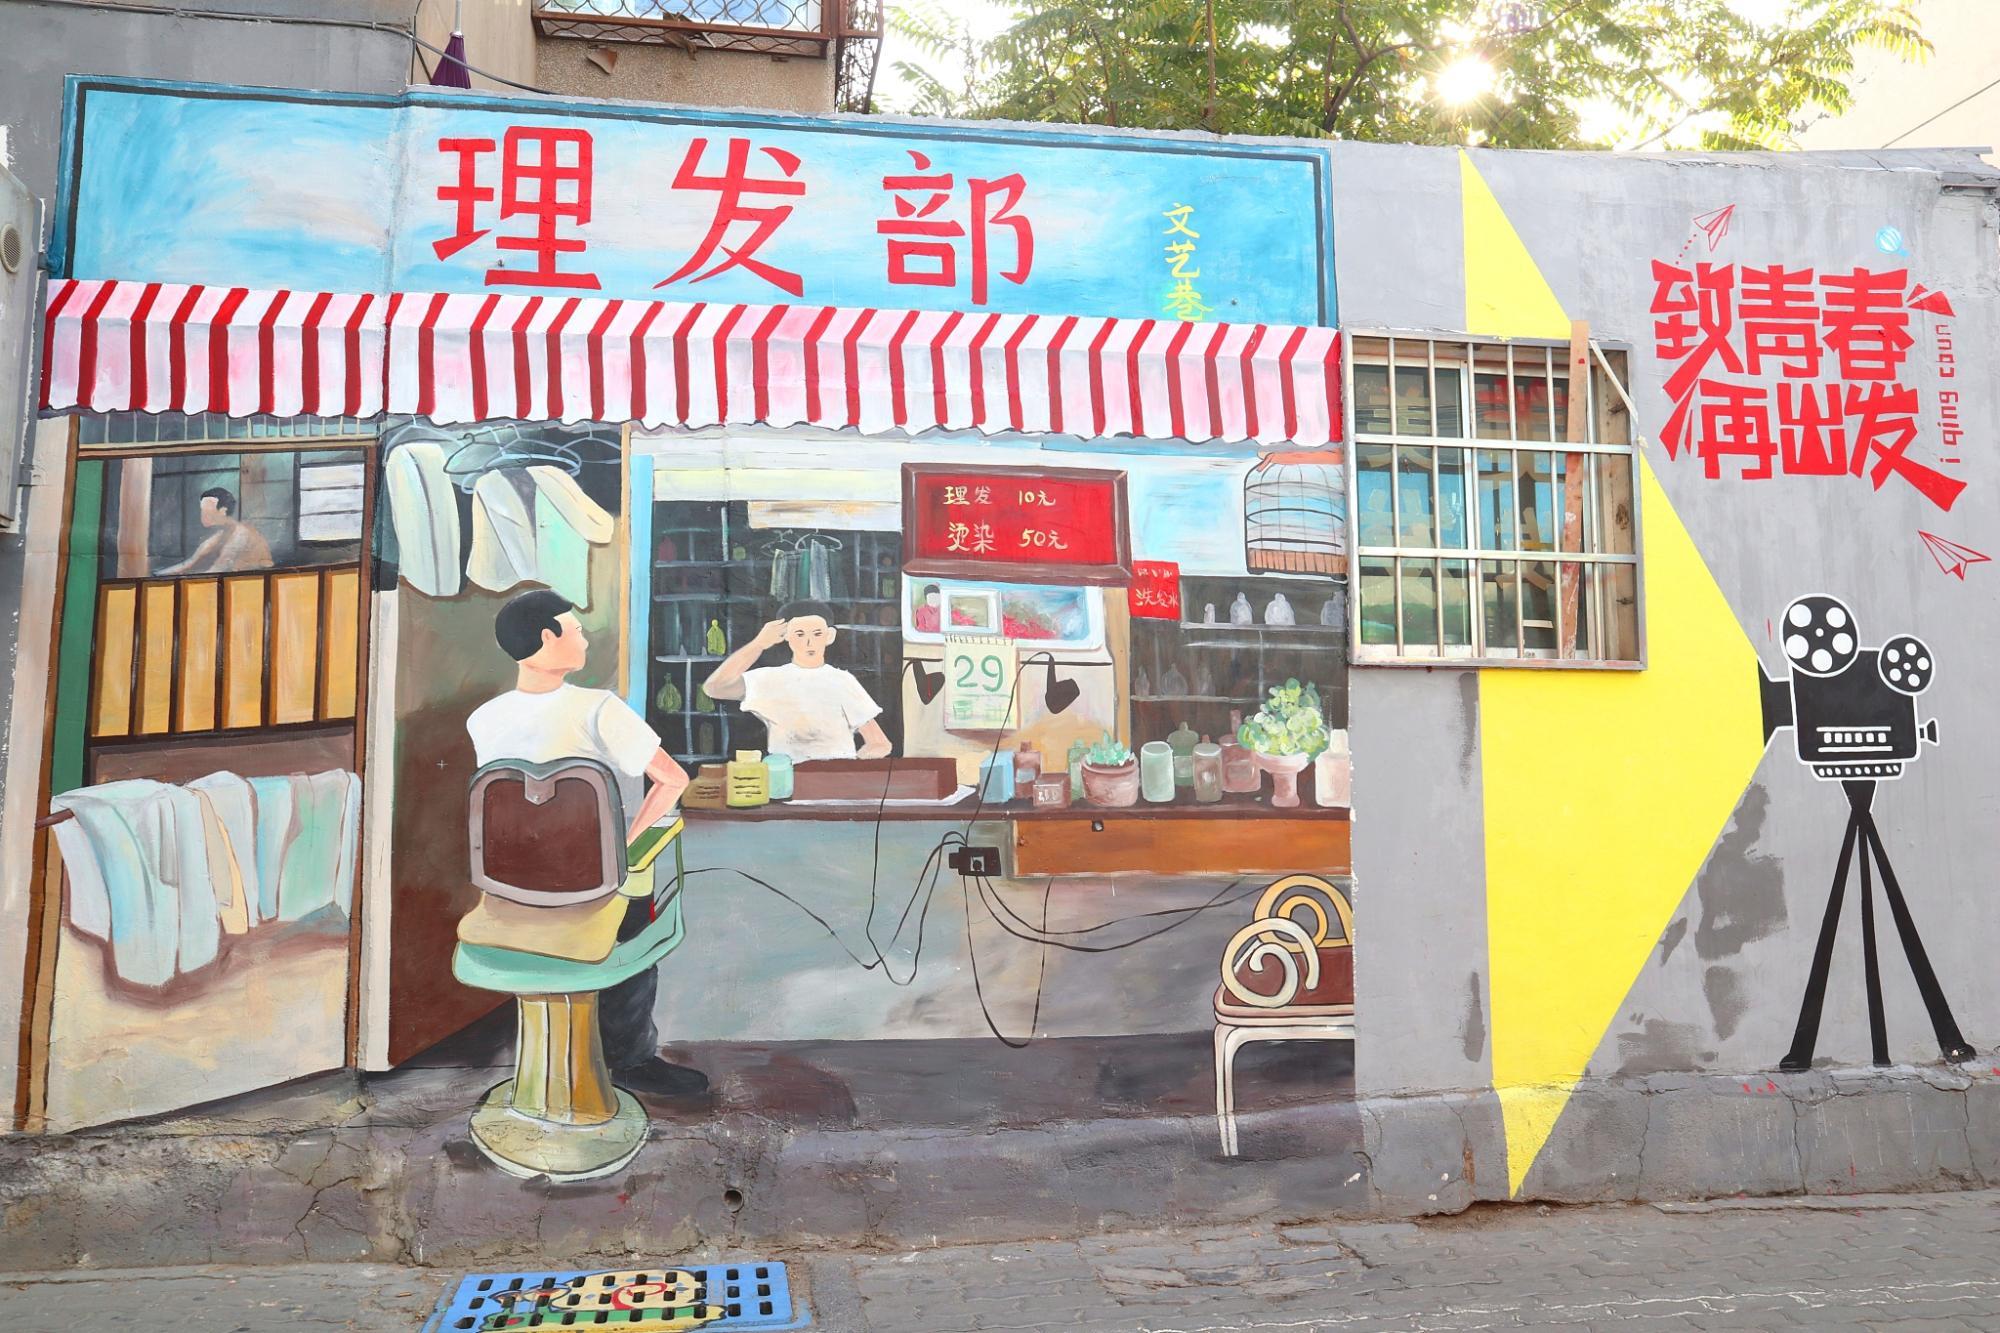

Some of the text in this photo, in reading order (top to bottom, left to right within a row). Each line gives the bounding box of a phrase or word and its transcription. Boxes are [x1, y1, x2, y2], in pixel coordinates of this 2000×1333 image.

[432, 125, 1034, 306] 理发部
[1162, 202, 1213, 321] 文艺巷
[1650, 259, 1915, 403] 致青春
[943, 486, 1056, 507] 理发 10元
[1659, 378, 1968, 512] 再出发
[946, 520, 1069, 554] 烫染 50元
[954, 654, 1004, 693] 29
